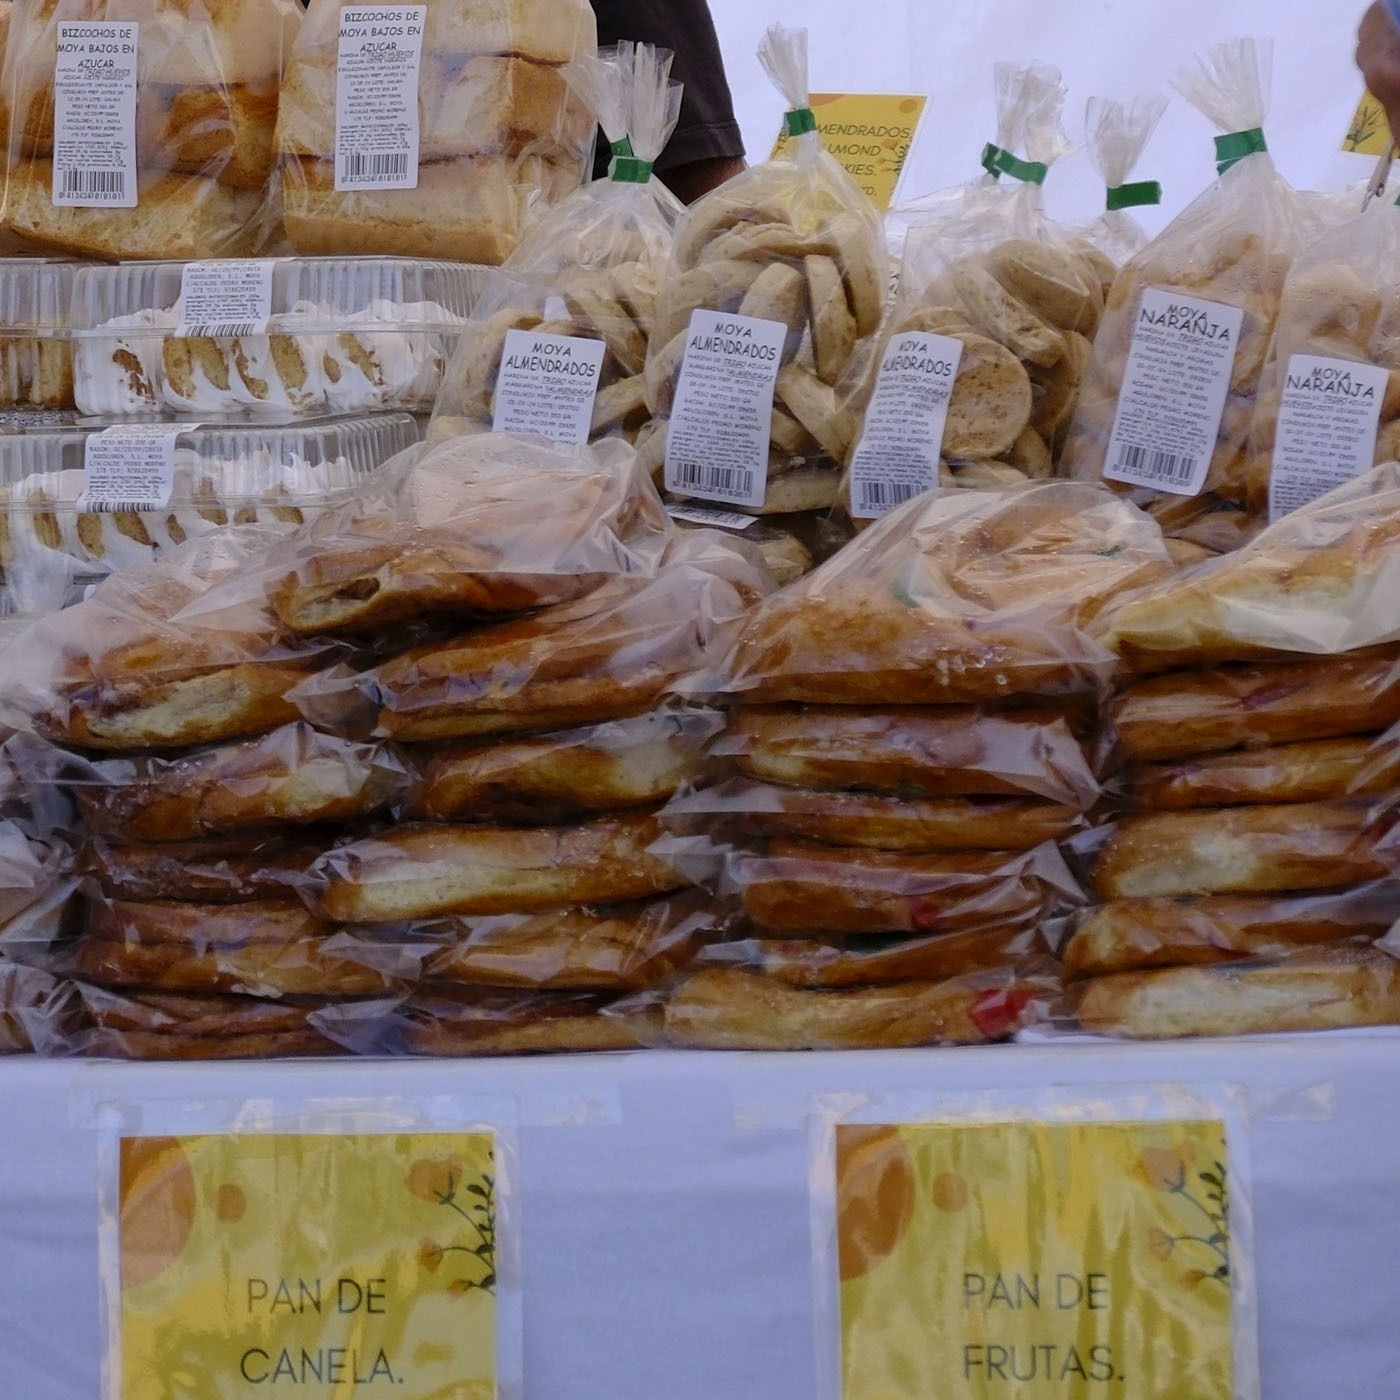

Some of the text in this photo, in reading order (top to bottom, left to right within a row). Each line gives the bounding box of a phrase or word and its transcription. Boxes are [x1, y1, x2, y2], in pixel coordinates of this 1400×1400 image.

[345, 11, 419, 22] BIZCOCHOS DE
[62, 28, 132, 38] BIZCOCHOS DE
[339, 26, 421, 37] MOYA BAJOS EN
[56, 44, 134, 53] MOYA BAJOS EN
[360, 42, 397, 52] AZUCAR
[78, 60, 114, 68] AZUCAR
[816, 123, 913, 142] MENDRADOS.
[824, 143, 882, 157] LMOND
[843, 163, 878, 177] KIES.
[1167, 304, 1208, 320] MOYA
[715, 323, 752, 338] MOYA
[1139, 308, 1230, 341] NARANJA
[532, 343, 571, 357] MOYA
[689, 335, 777, 360] ALMENDRADOS
[506, 355, 596, 377] ALMENDRADOS
[1312, 367, 1351, 380] MOYA
[1287, 375, 1375, 399] NARANJA
[248, 1278, 386, 1314] PAN DE
[964, 1273, 1108, 1310] PAN DE
[240, 1347, 404, 1385] CANELA.
[963, 1345, 1126, 1381] FRUTAS.
